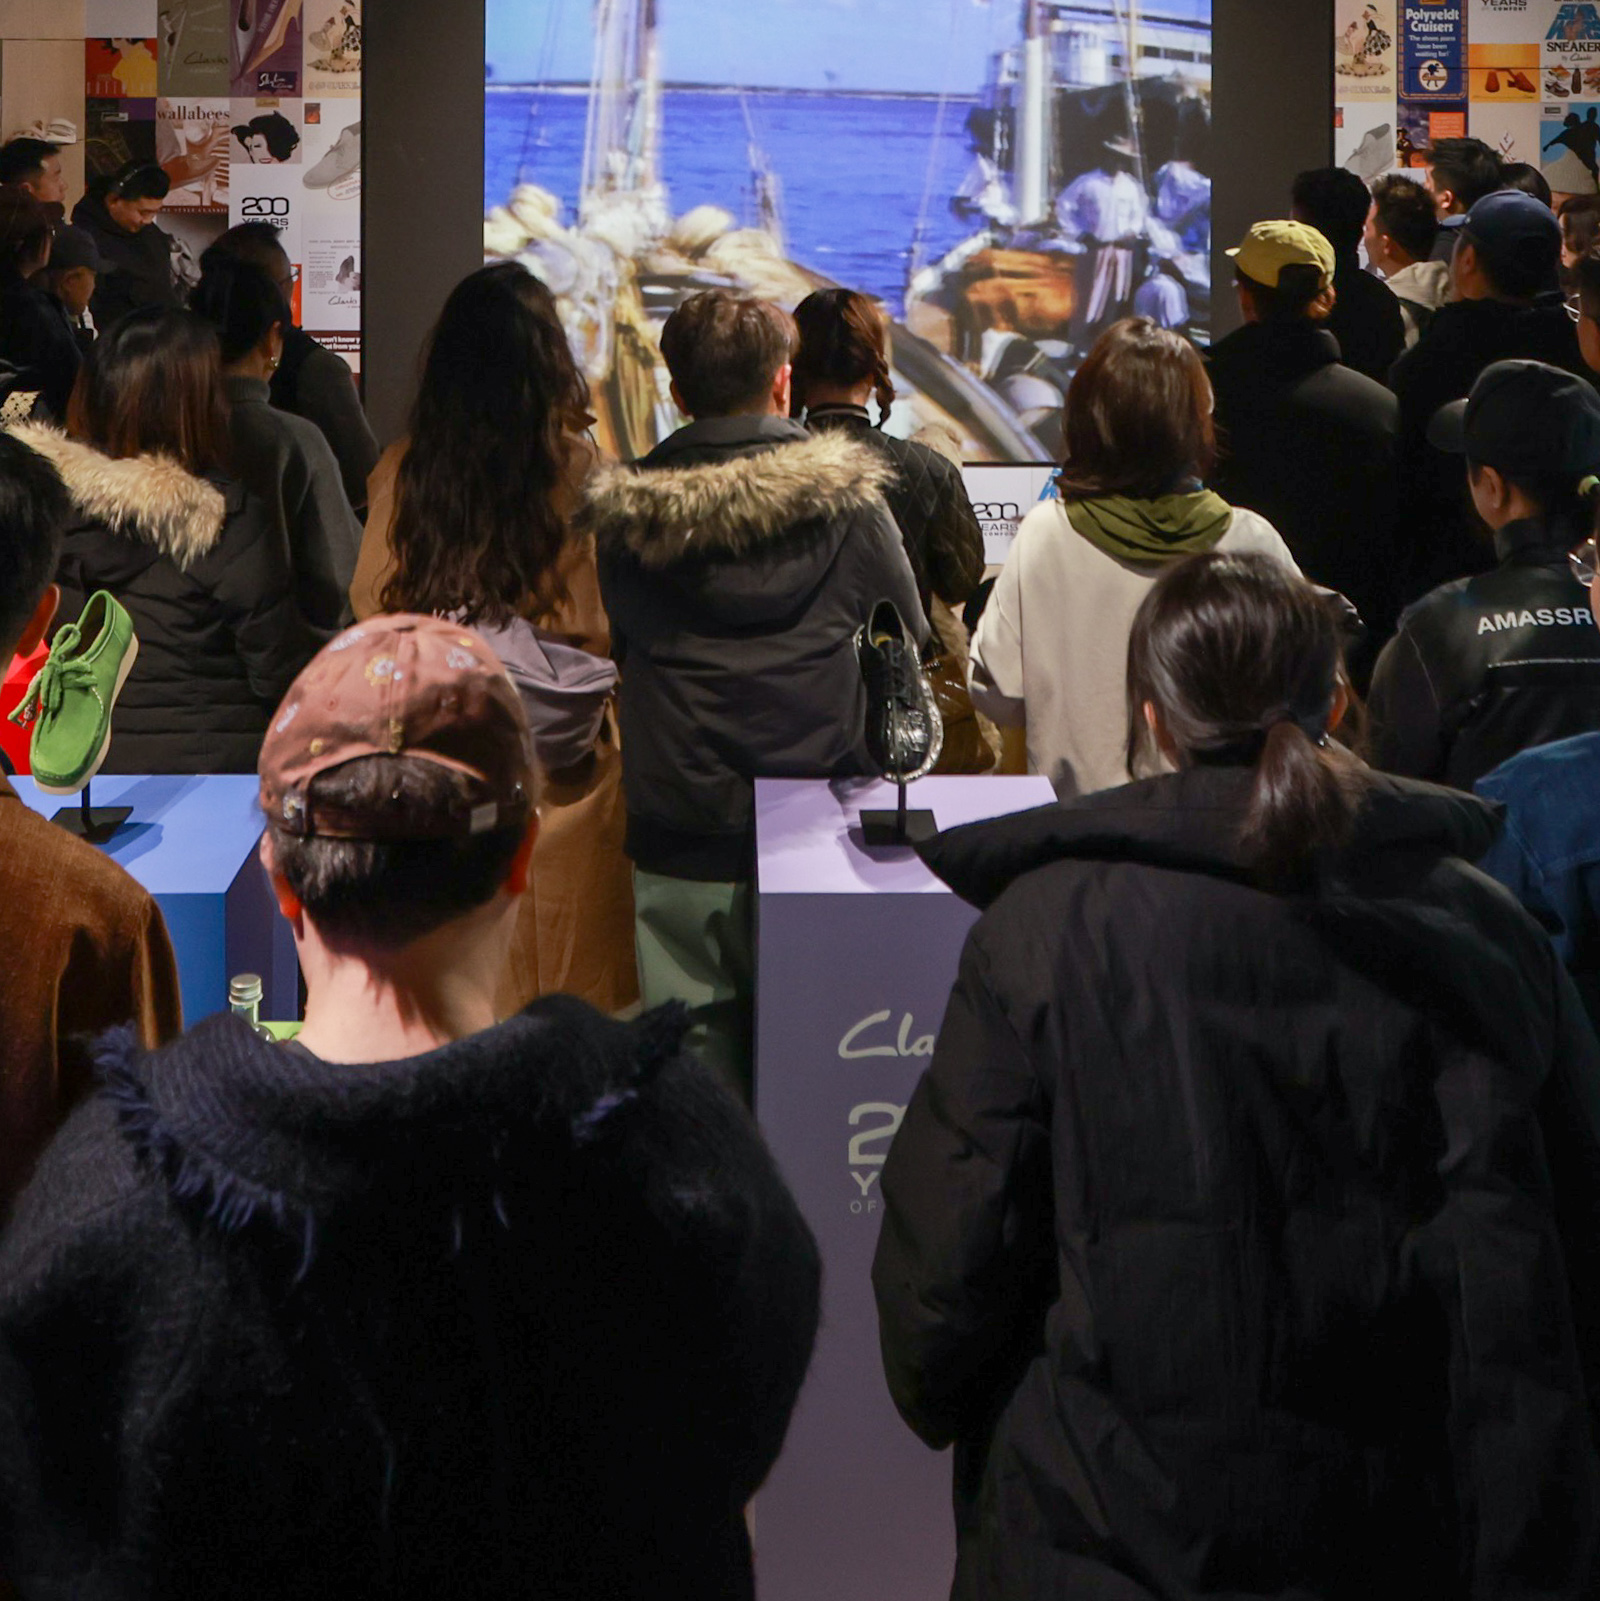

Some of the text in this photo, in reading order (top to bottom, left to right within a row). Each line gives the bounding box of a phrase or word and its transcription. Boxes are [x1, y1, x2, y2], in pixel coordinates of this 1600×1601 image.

[1405, 8, 1460, 22] Polyveldt
[1410, 20, 1454, 33] Cruisers
[157, 105, 230, 120] wallabees
[241, 197, 290, 216] 200
[328, 295, 358, 306] Clarks
[980, 523, 1018, 532] EARS
